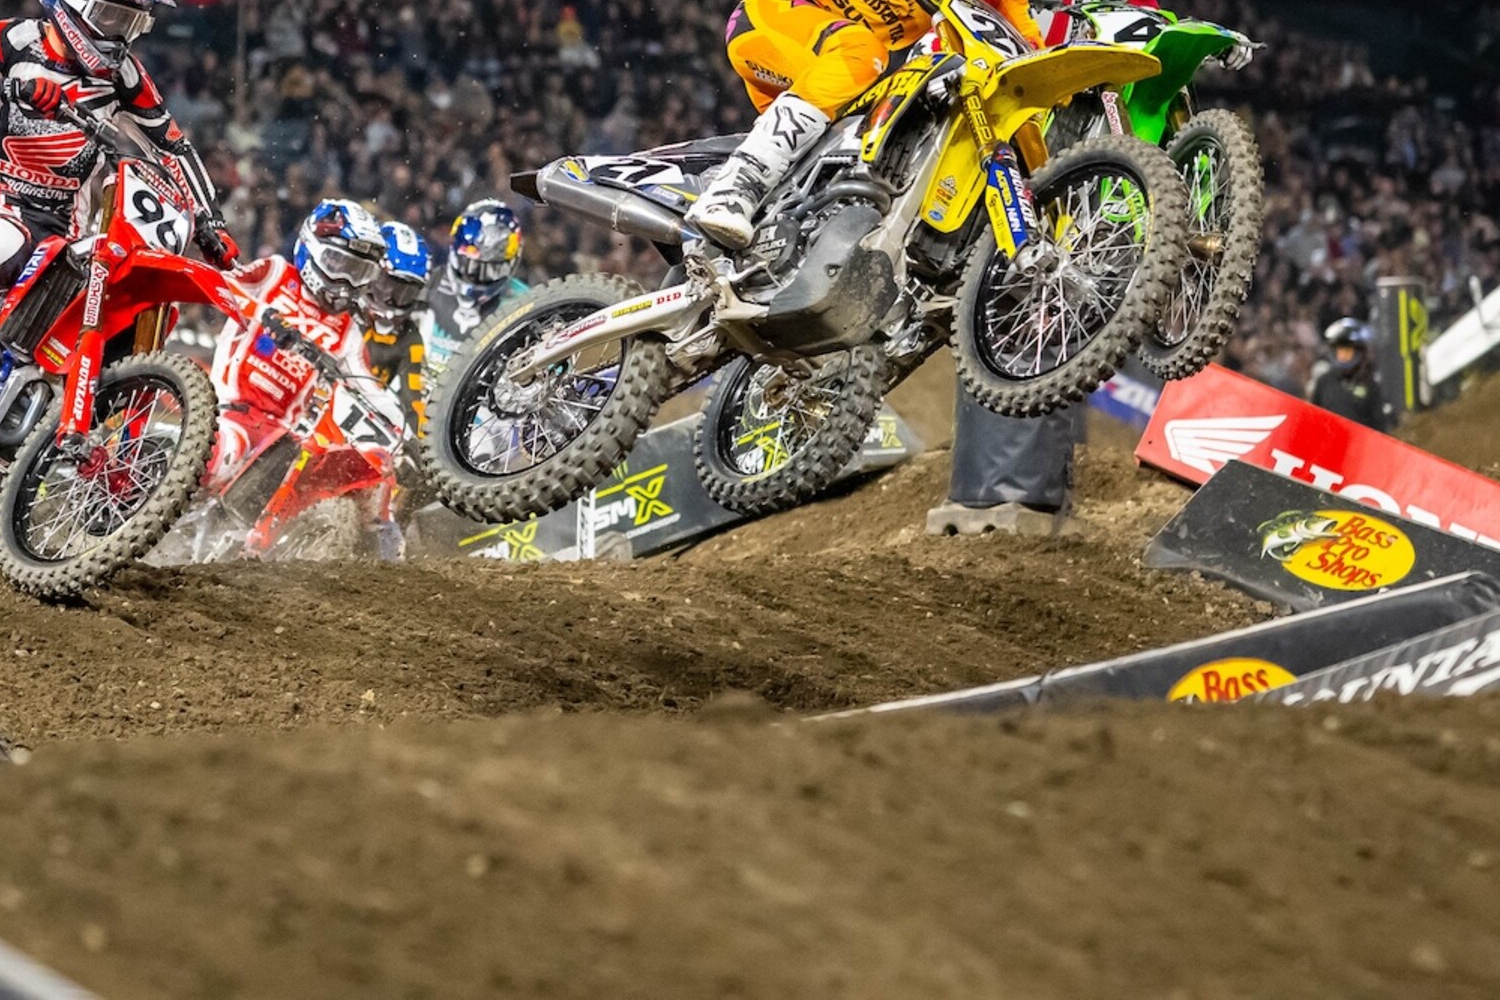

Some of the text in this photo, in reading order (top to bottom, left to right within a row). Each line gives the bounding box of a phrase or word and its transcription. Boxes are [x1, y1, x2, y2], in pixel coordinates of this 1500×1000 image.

[1113, 17, 1164, 44] 4
[1008, 167, 1037, 228] DUNLOP
[131, 189, 183, 256] 96
[72, 354, 92, 421] DUNLOP
[246, 354, 298, 394] HONDA
[595, 475, 675, 531] SMX
[1320, 533, 1370, 563] Pro
[1338, 515, 1399, 548] Bass
[1306, 552, 1382, 589] Shops
[1202, 668, 1270, 703] Bass
